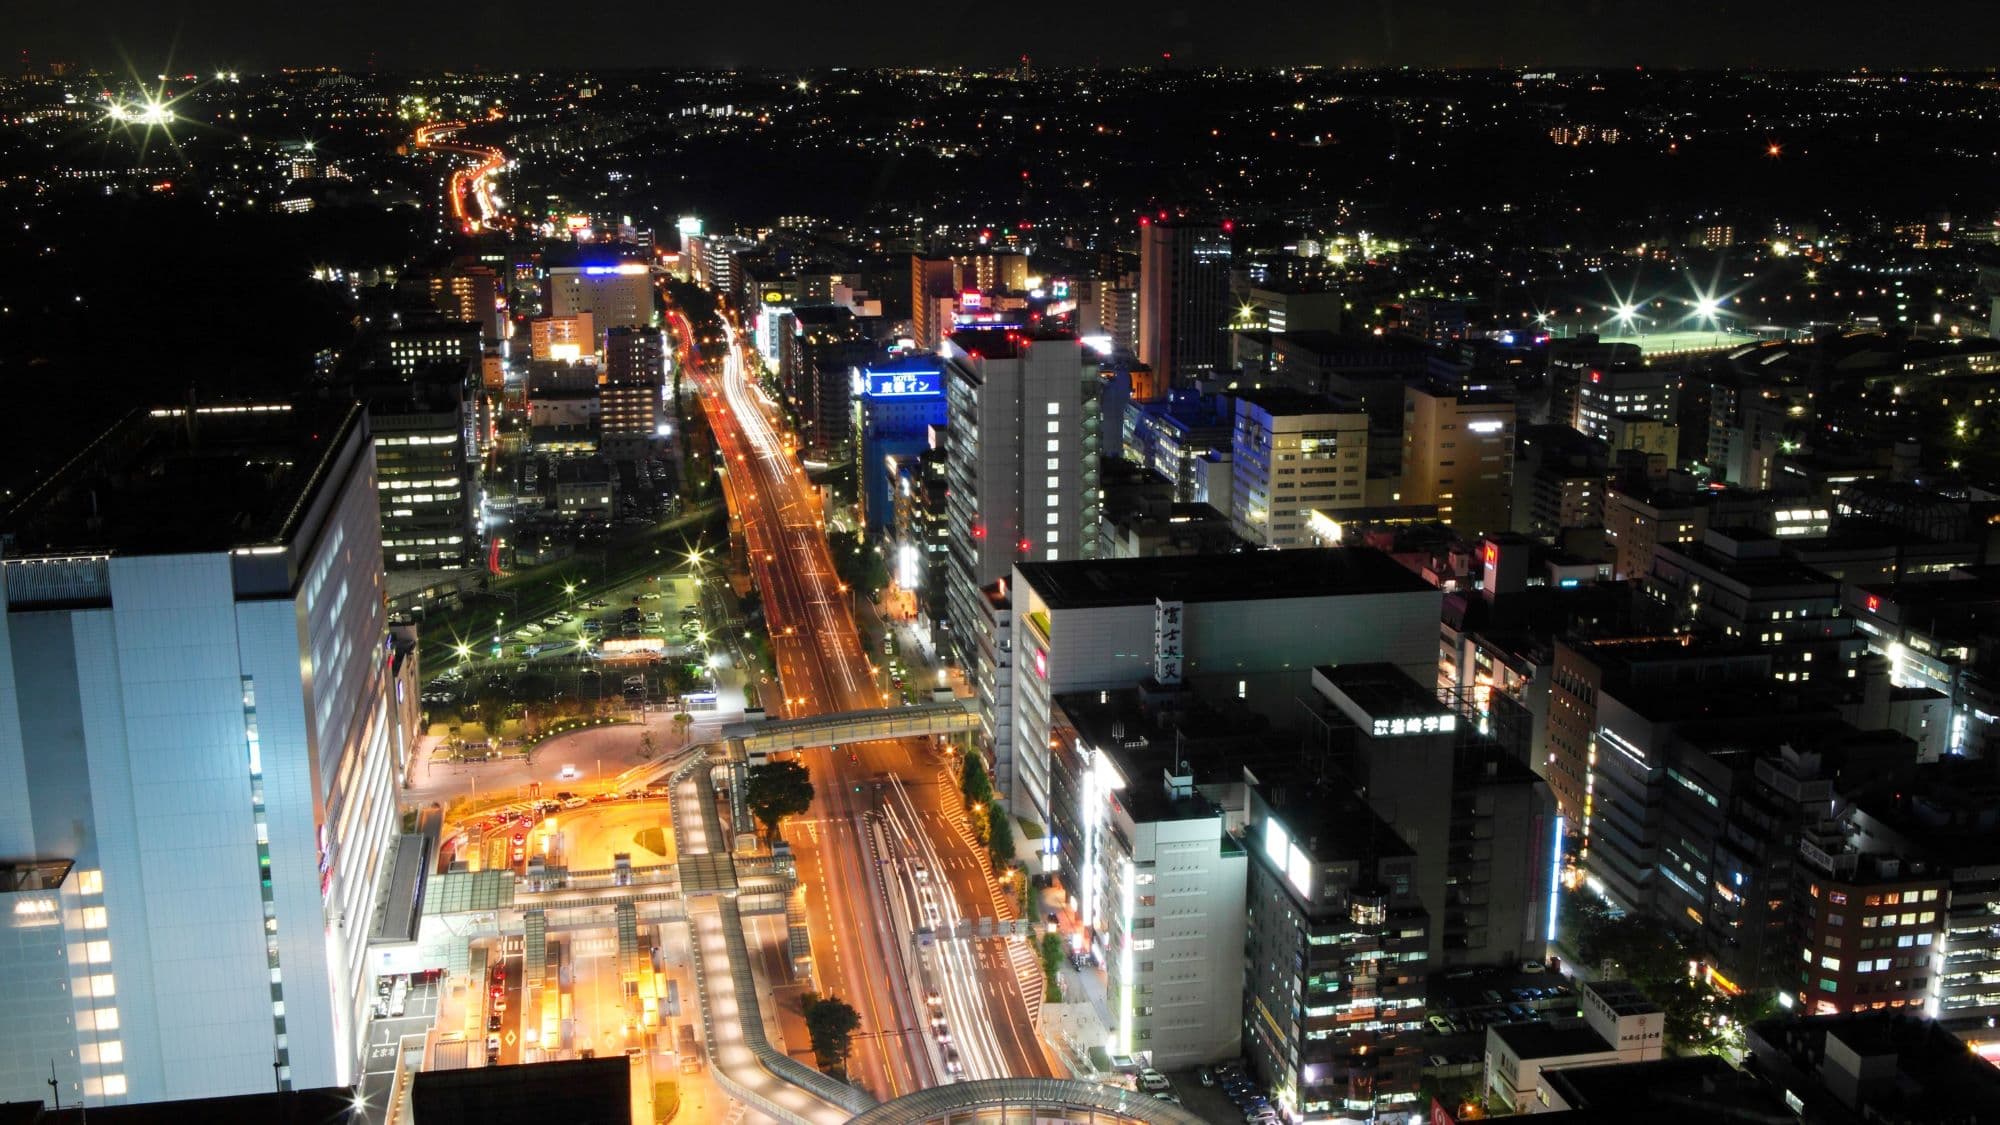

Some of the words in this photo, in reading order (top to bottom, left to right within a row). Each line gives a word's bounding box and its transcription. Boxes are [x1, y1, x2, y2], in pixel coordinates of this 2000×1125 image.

[893, 374, 917, 382] HOTEL
[1163, 606, 1181, 679] 富士火災
